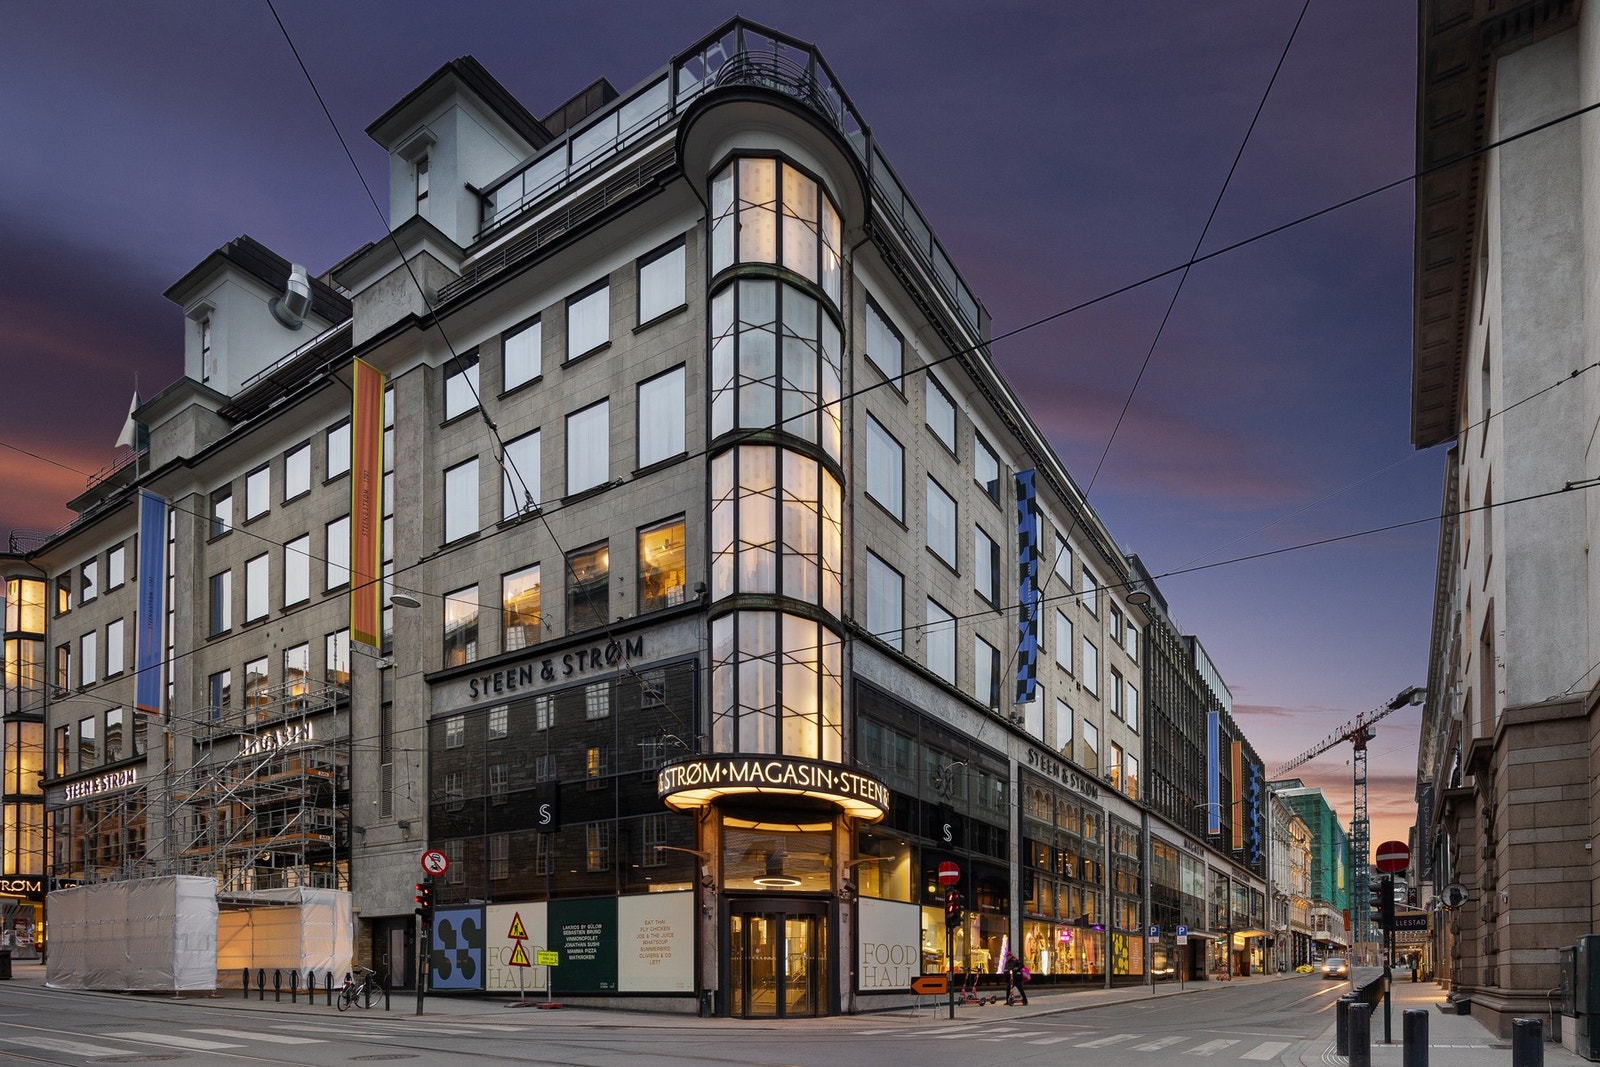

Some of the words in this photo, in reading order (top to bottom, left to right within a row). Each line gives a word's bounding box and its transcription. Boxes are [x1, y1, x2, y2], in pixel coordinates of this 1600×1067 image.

[469, 664, 532, 699] STEEN
[540, 658, 555, 681] &
[562, 635, 643, 676] STRØM
[65, 779, 93, 801] STEEN
[94, 777, 101, 794] &
[103, 768, 137, 792] STRØM
[664, 762, 720, 790] STRØM
[729, 762, 833, 789] MAGASIN
[840, 771, 883, 803] STEEN
[1028, 748, 1060, 778] STEEN
[1062, 766, 1068, 784] &
[1070, 773, 1098, 799] STRØM
[1150, 926, 1157, 936] P
[1178, 926, 1185, 935] P
[862, 942, 918, 966] FOOD
[487, 968, 546, 989] HALL
